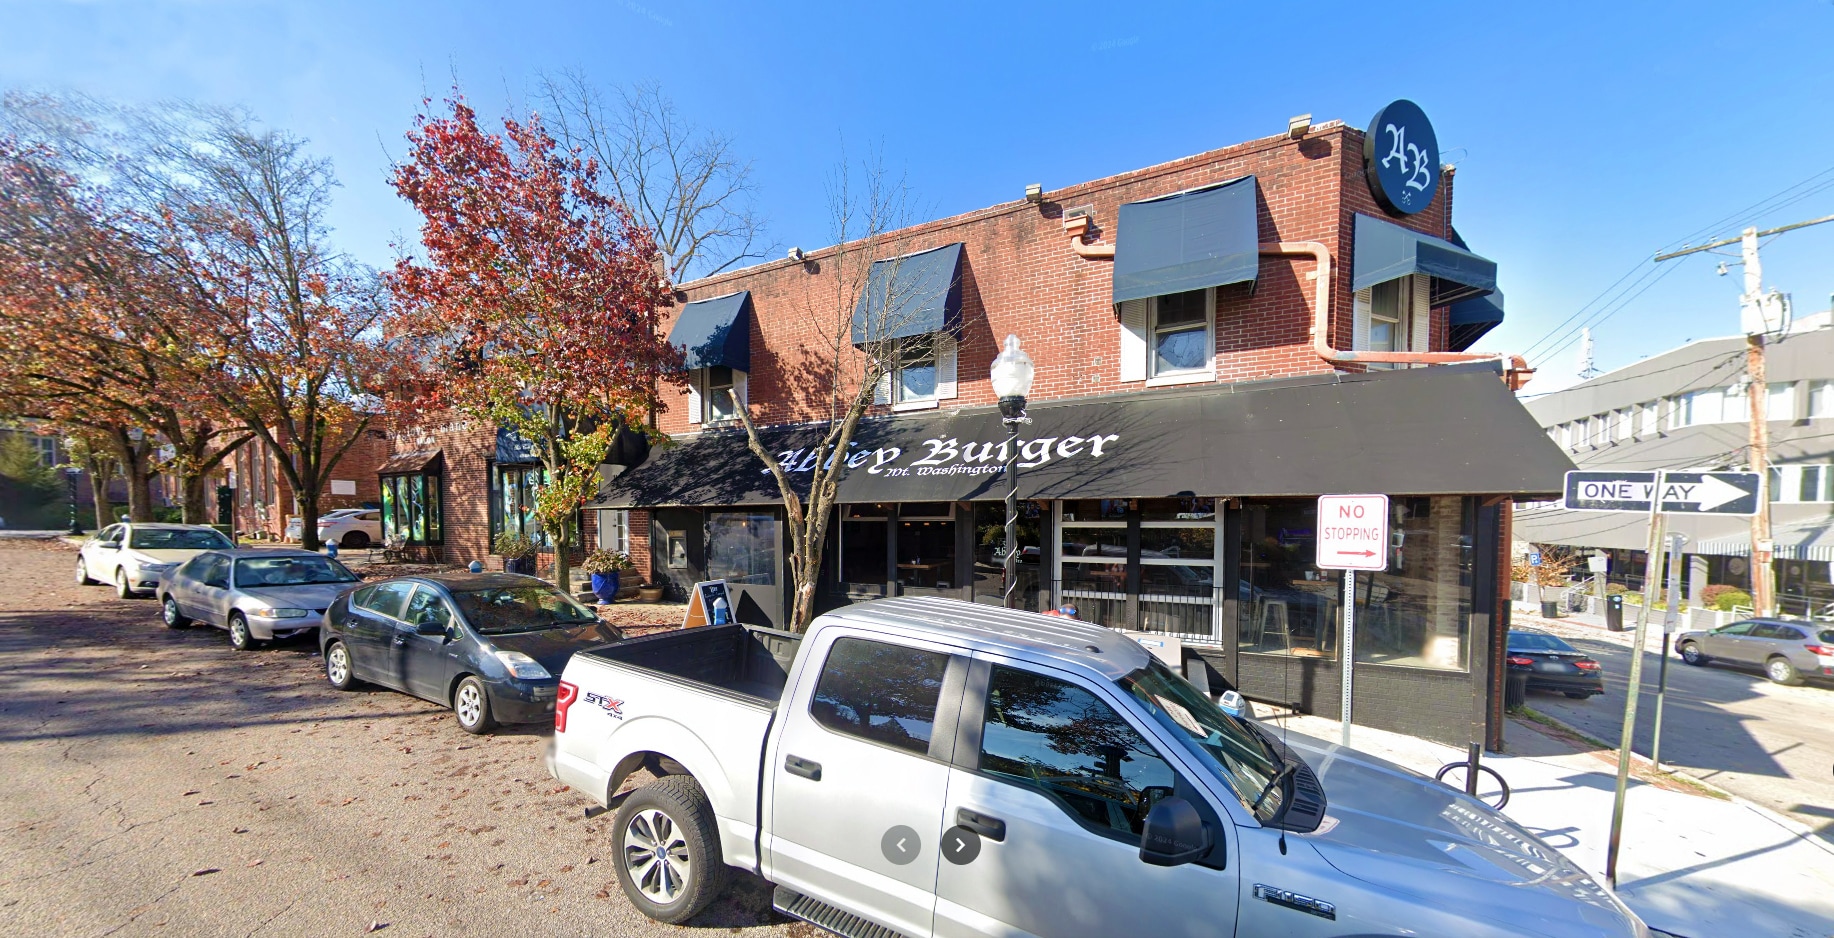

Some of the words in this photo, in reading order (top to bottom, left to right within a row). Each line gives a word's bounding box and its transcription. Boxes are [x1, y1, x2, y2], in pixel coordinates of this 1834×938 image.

[910, 434, 1119, 468] Burger
[916, 463, 1006, 477] Washington
[1585, 483, 1632, 499] ONE
[1339, 505, 1365, 519] NO
[1324, 527, 1379, 541] STOPPING
[994, 546, 1021, 559] Aby
[584, 691, 625, 715] STX
